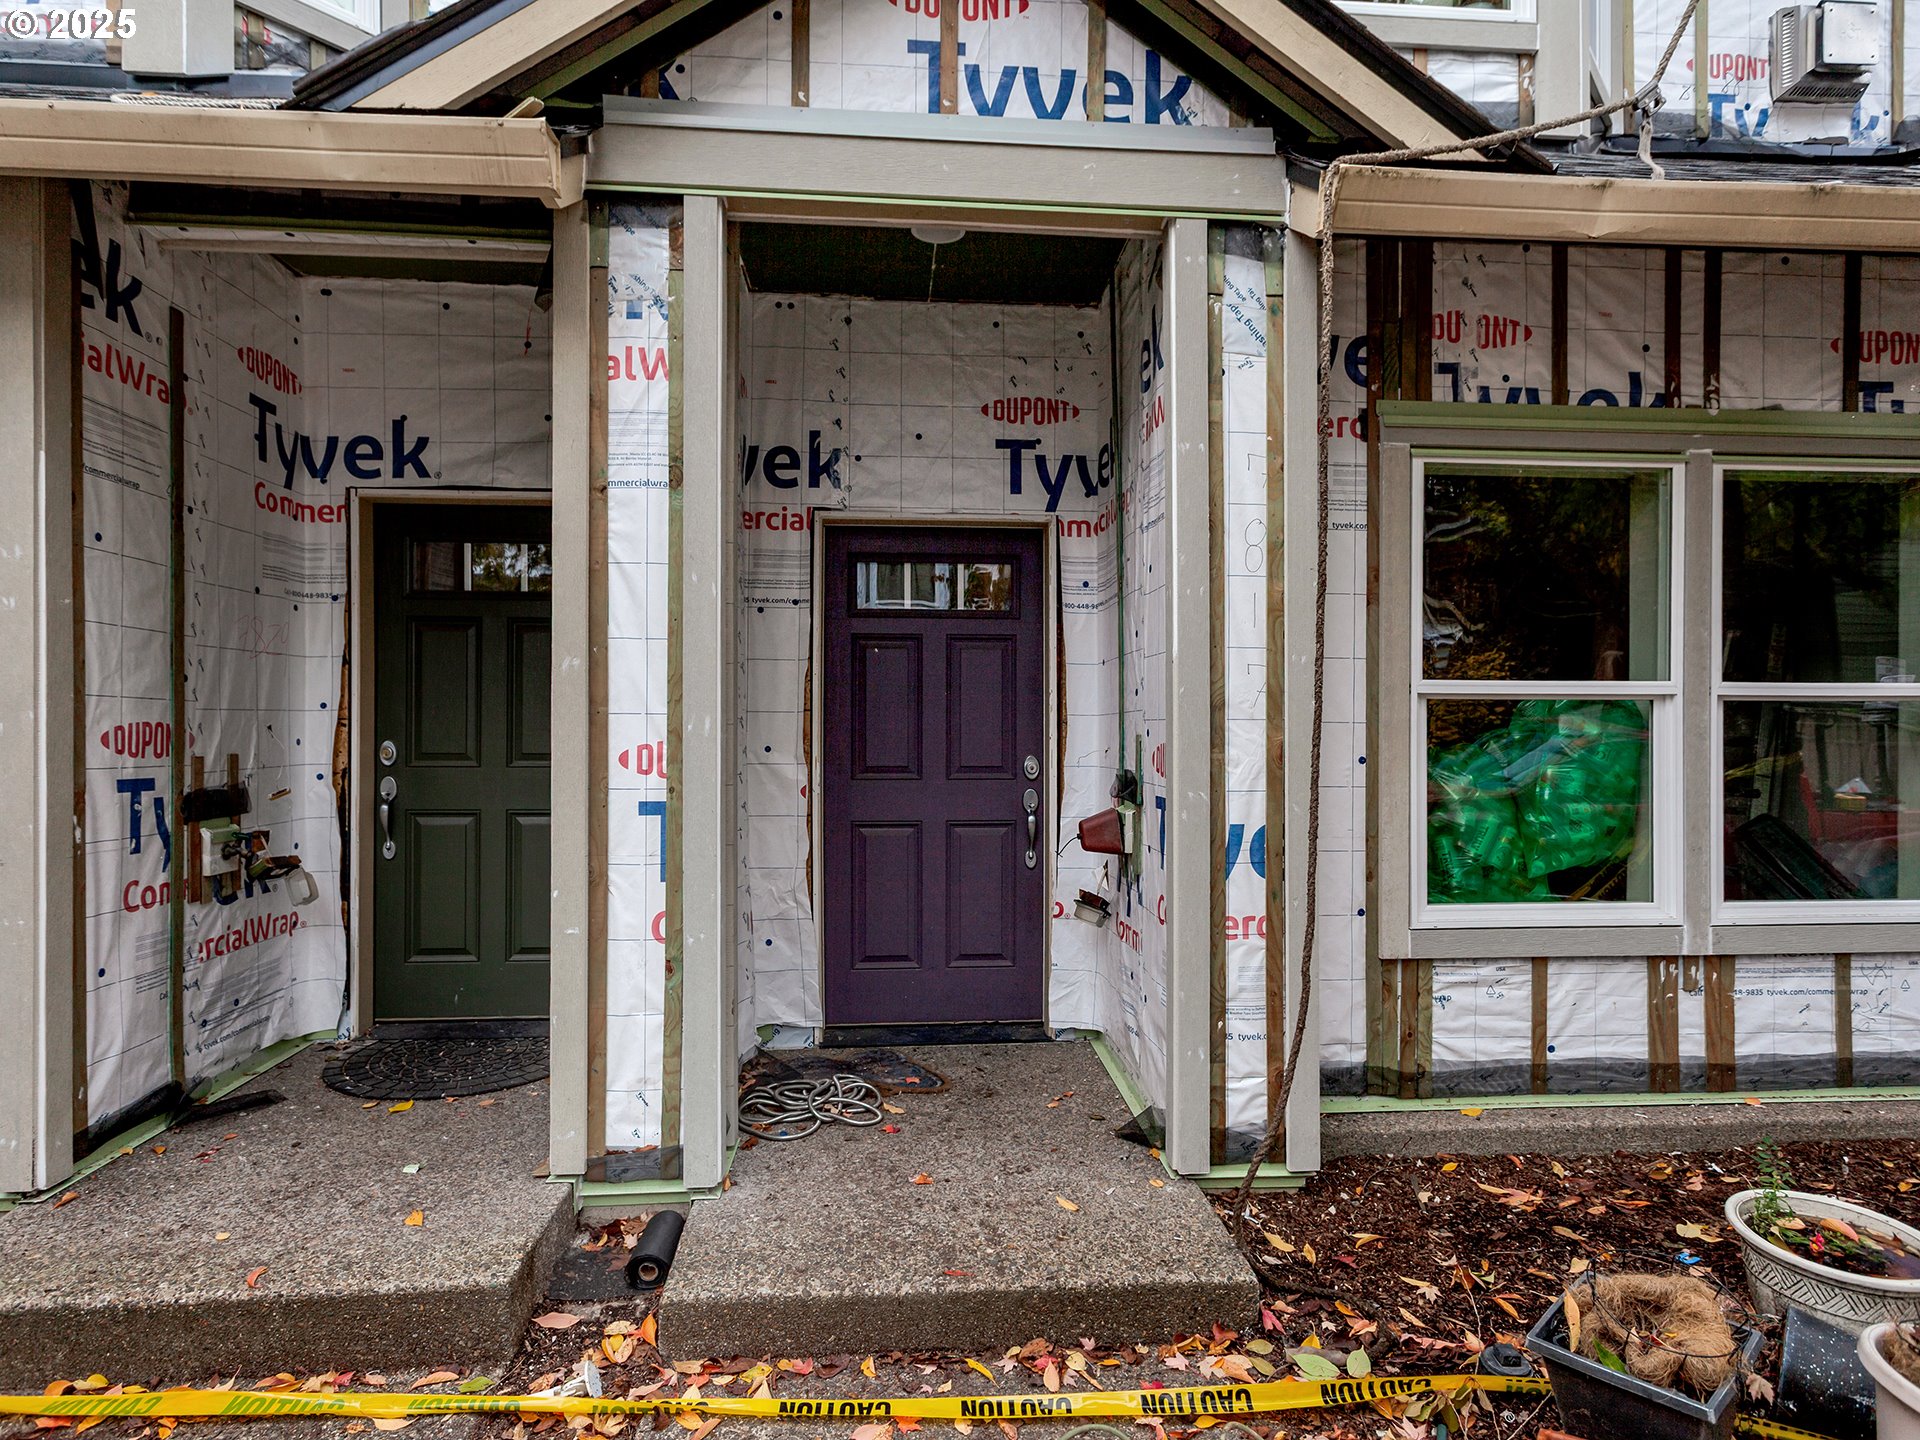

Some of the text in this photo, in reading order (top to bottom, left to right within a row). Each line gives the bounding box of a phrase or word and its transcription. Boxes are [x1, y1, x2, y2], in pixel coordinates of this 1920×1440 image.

[1709, 53, 1768, 82] UPONT
[1432, 310, 1520, 349] DUONT
[1860, 330, 1920, 365] UPON
[246, 346, 298, 395] DUPONT
[993, 397, 1070, 425] DUPONT
[249, 392, 432, 491] Tyvek
[1140, 1388, 1254, 1415] CAUTION
